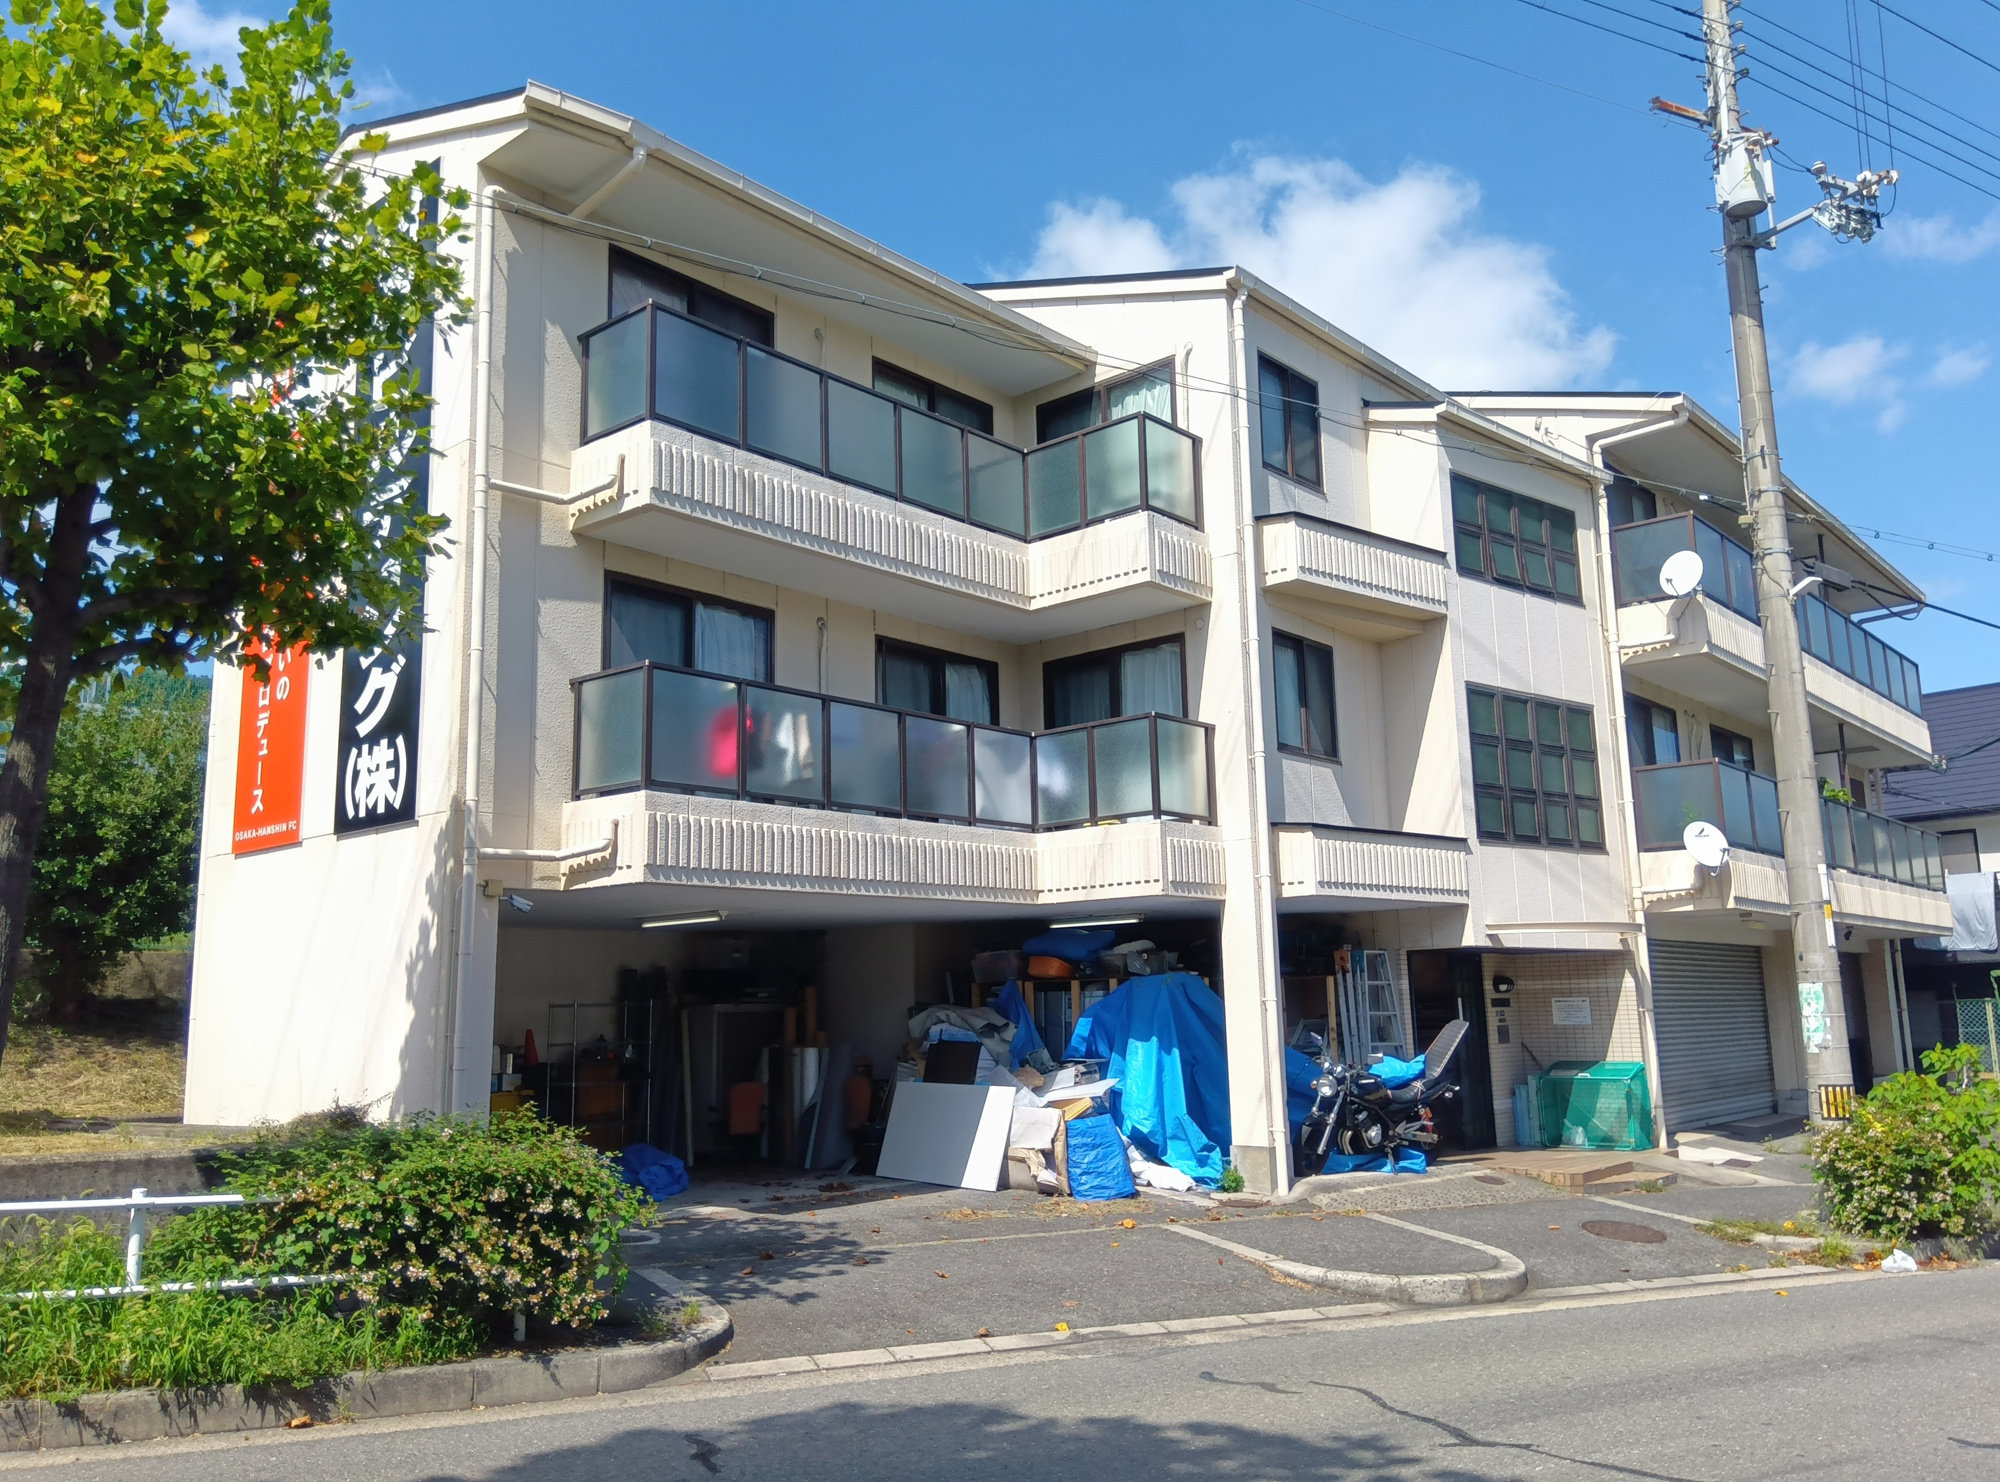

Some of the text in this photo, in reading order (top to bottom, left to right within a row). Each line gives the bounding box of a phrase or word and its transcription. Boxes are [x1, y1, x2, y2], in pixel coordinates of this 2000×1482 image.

[250, 655, 274, 815] ロデュース
[235, 820, 298, 841] OSAKA-HANSHIN FC
